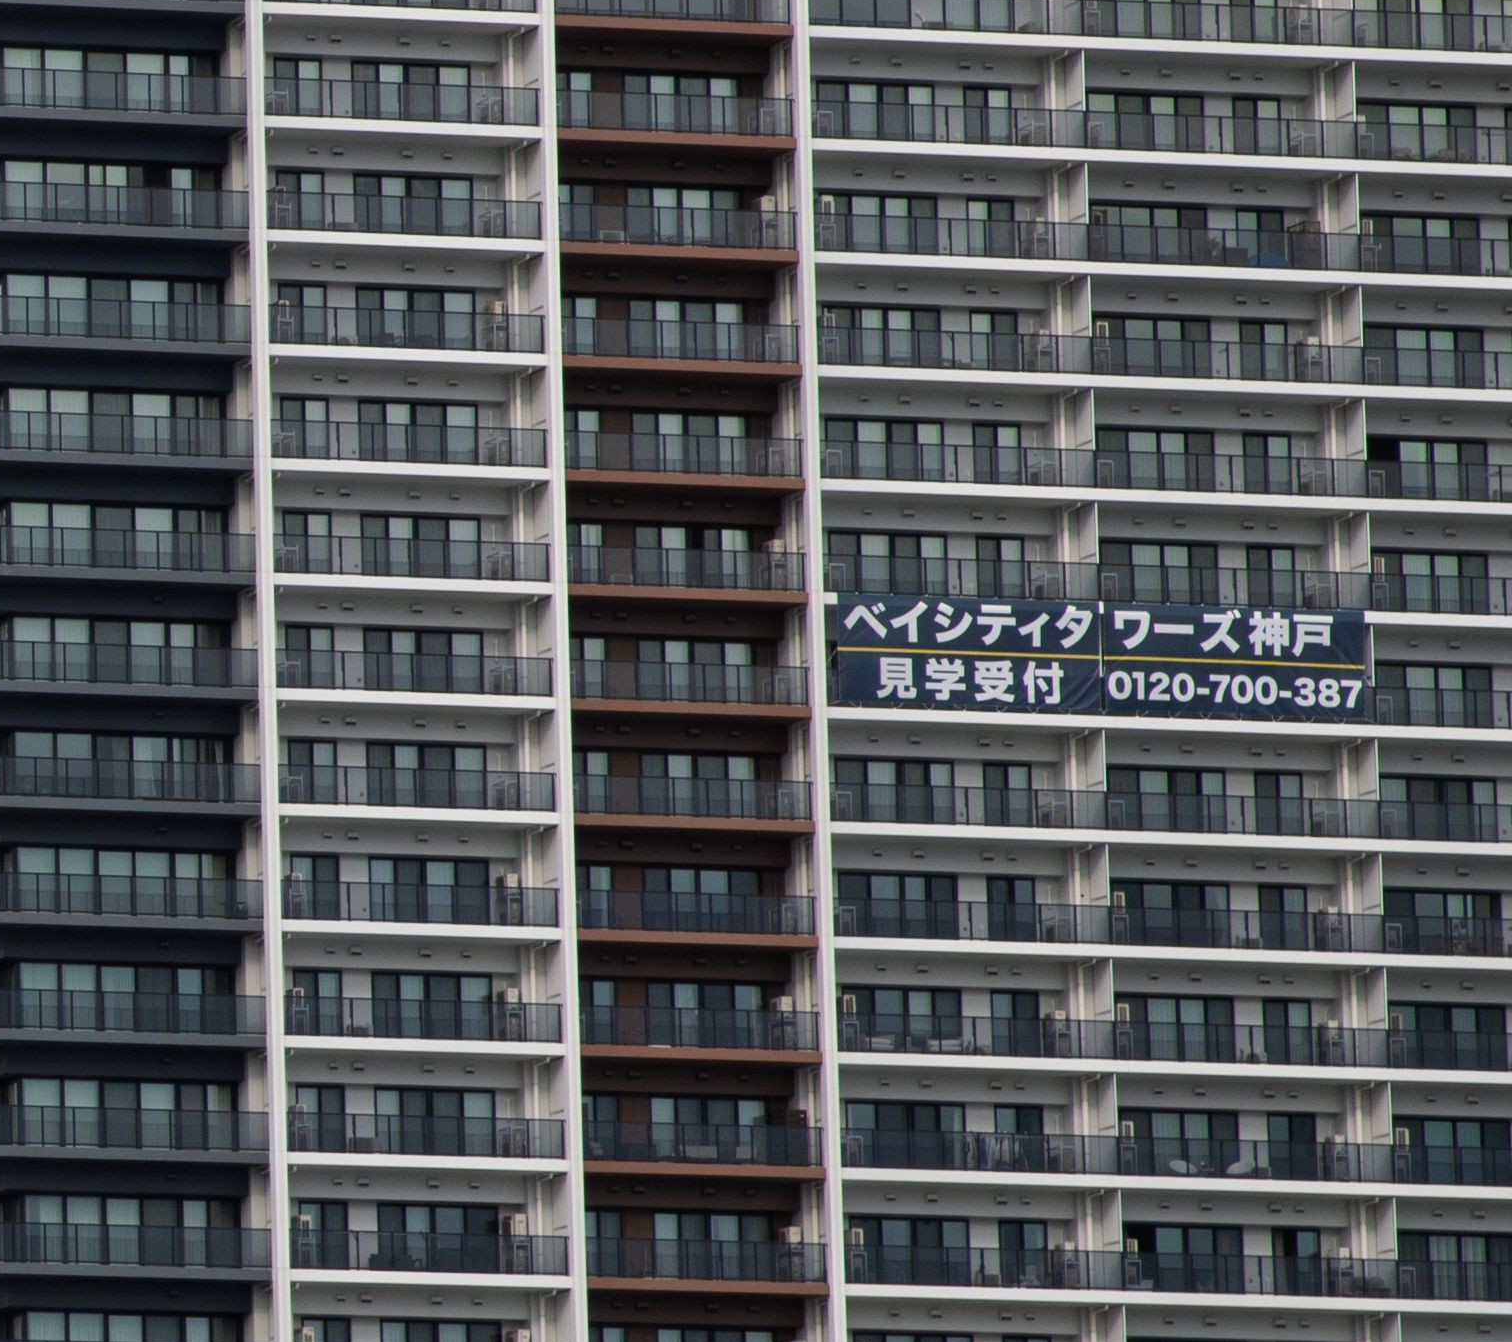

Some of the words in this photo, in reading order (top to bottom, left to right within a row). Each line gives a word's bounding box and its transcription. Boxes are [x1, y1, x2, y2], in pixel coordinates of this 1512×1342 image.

[876, 656, 1064, 704] 見学受付
[1107, 670, 1362, 709] 0120-700-387
